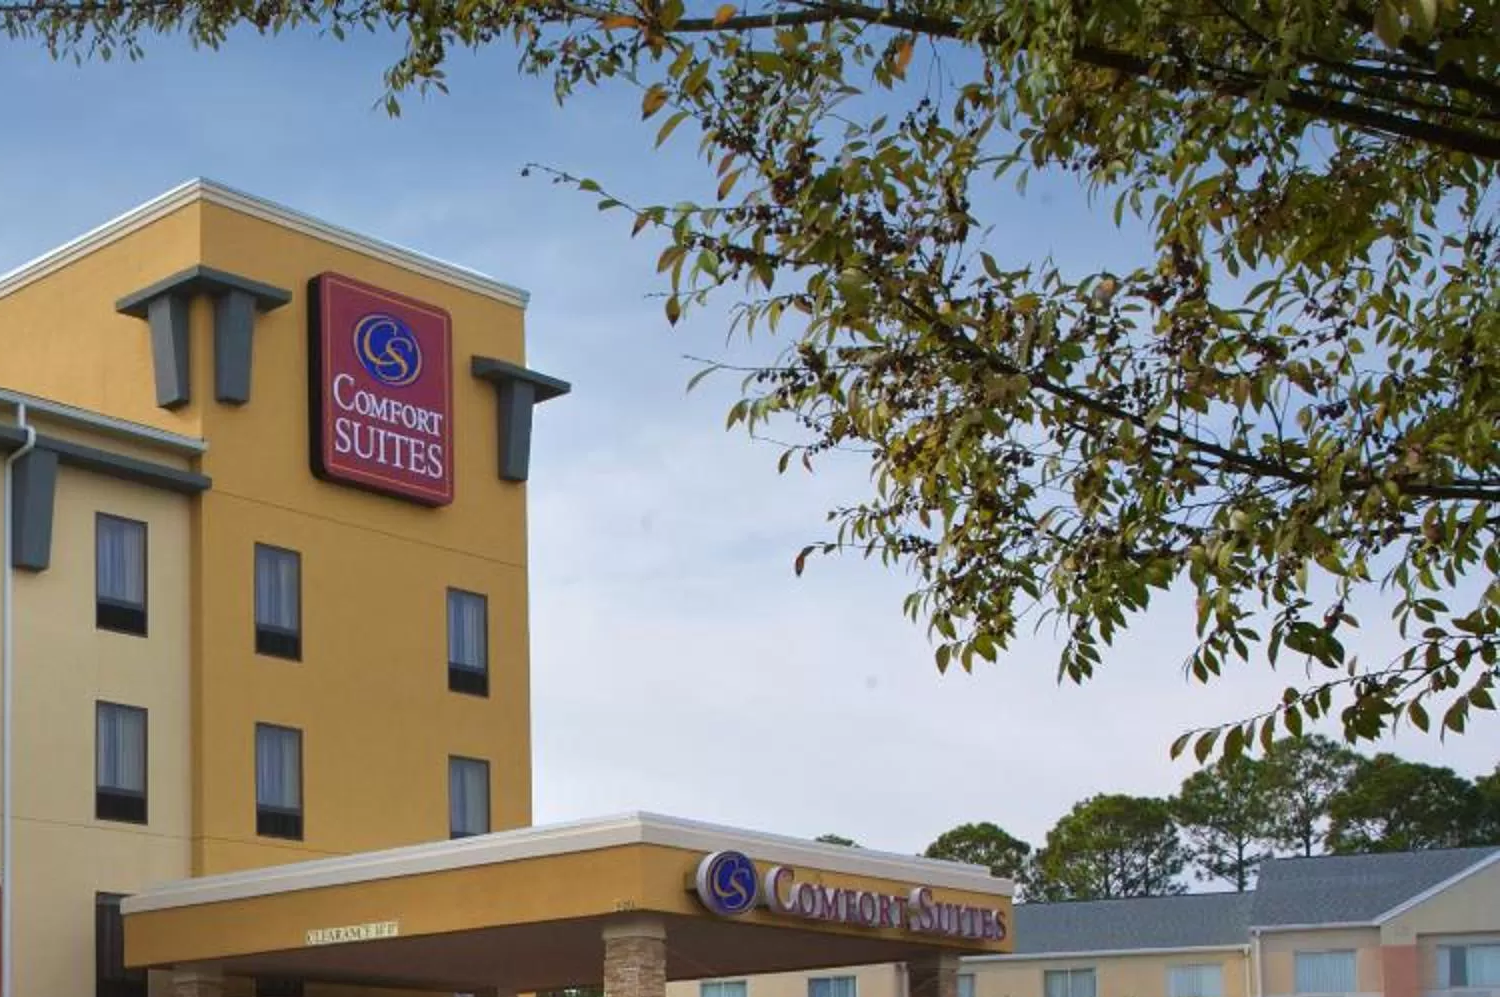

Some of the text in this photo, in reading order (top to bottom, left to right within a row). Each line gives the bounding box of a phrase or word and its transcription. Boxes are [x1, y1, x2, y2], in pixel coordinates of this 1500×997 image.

[333, 373, 443, 437] COMFORT
[334, 417, 444, 479] SUITES
[765, 863, 1007, 941] COMFORT SUITES
